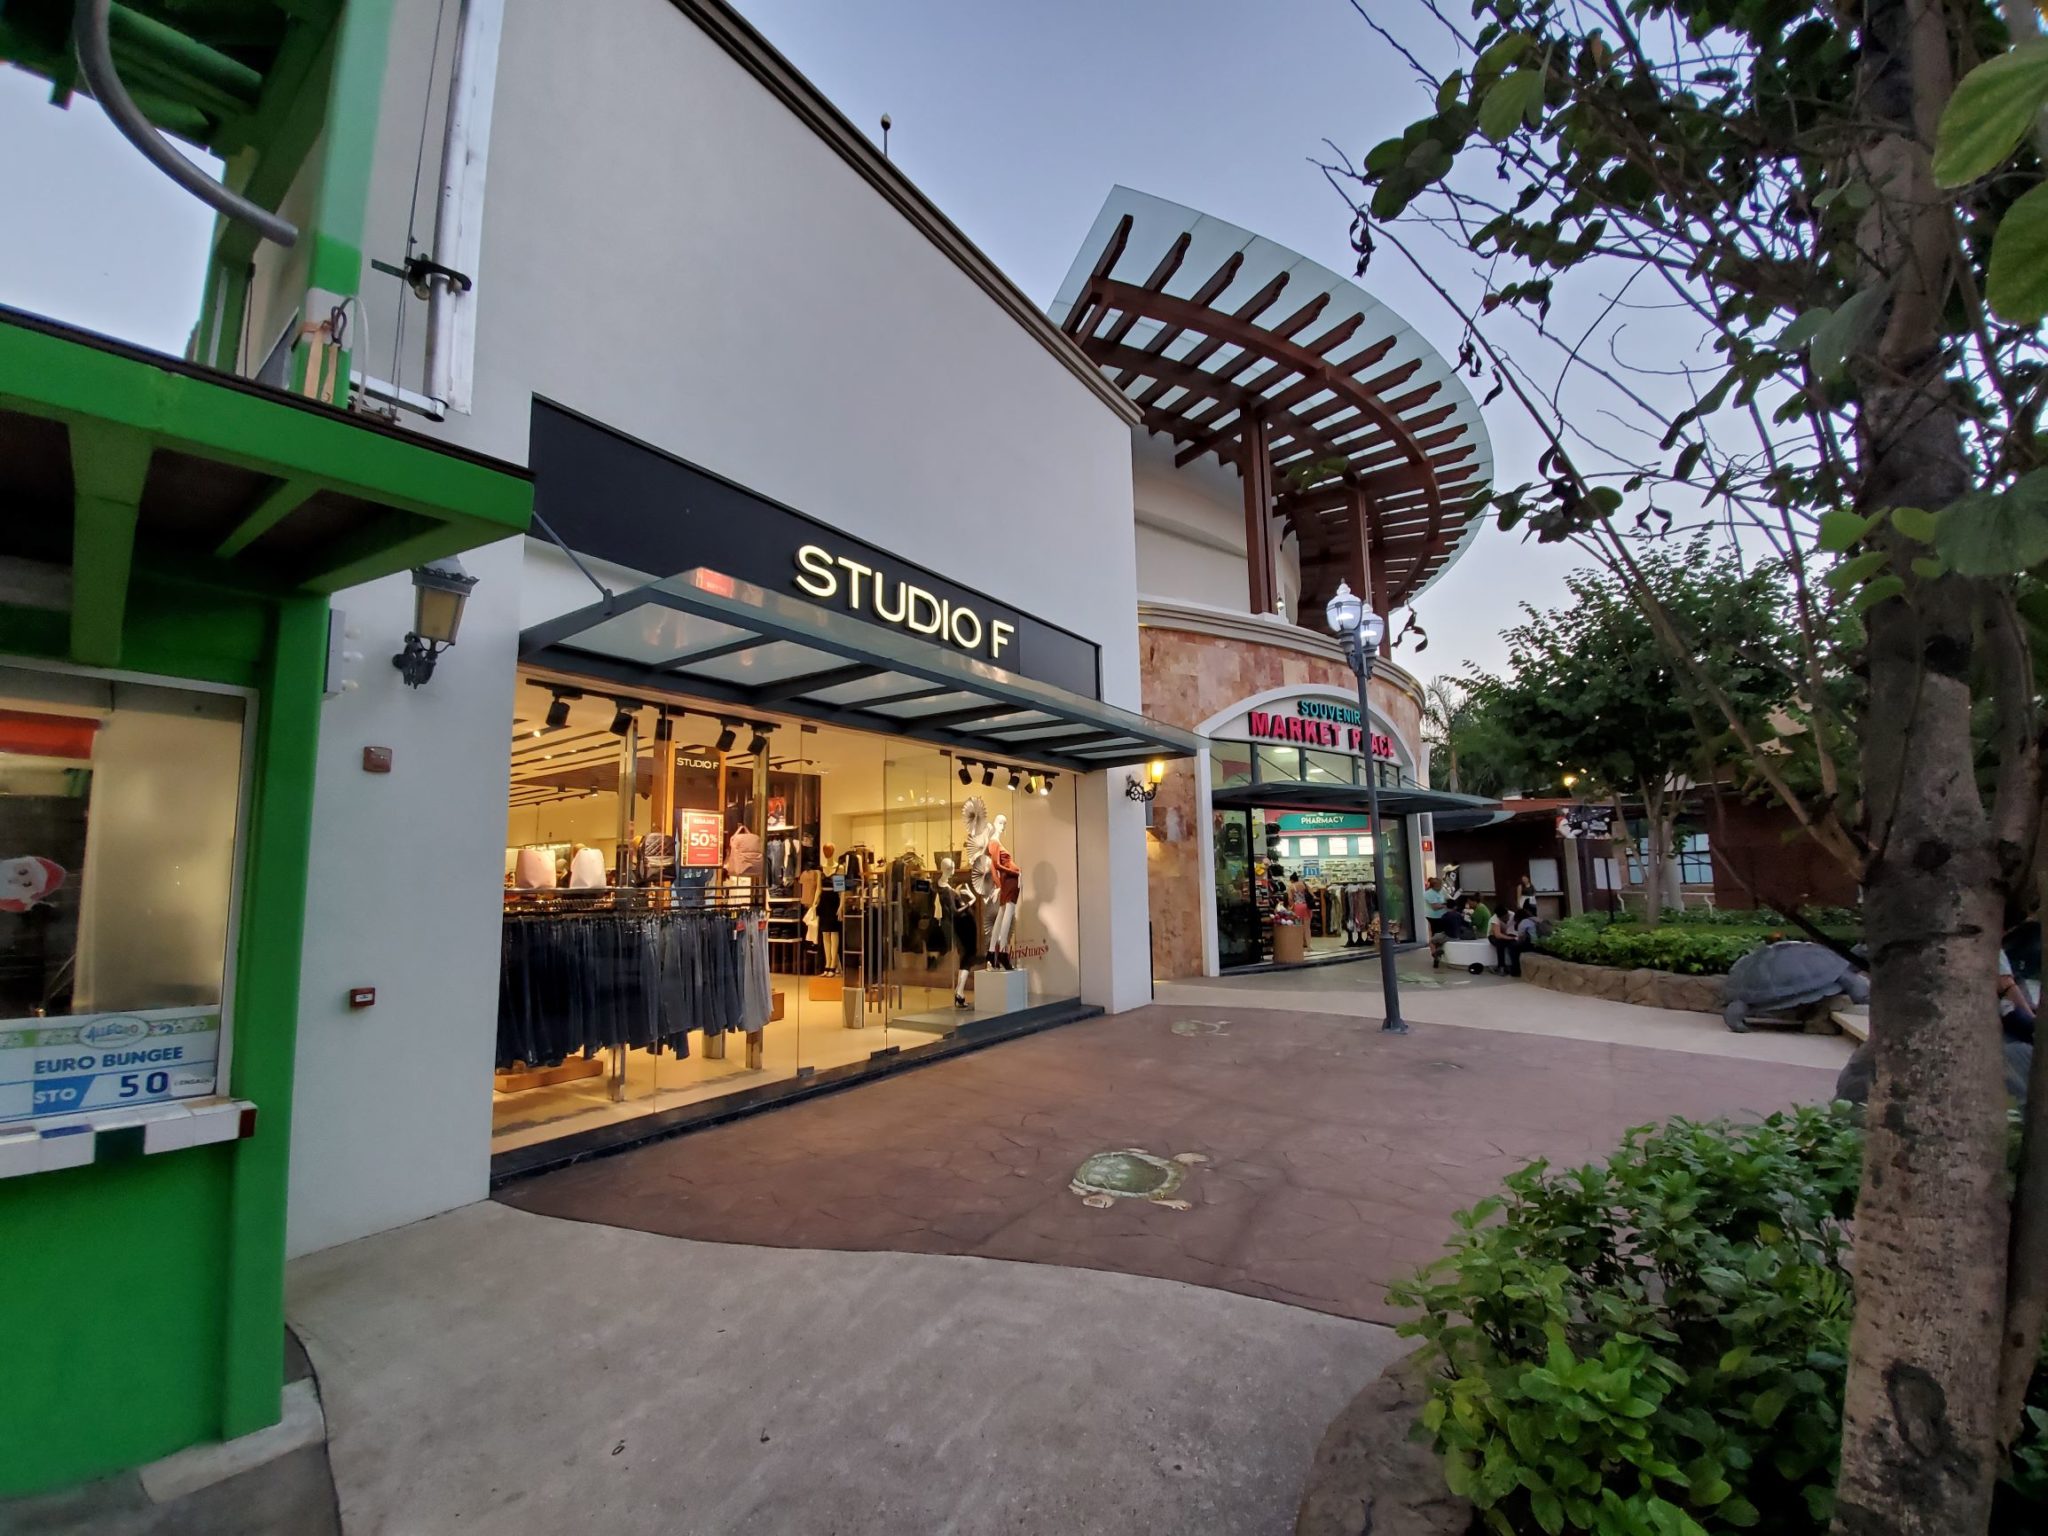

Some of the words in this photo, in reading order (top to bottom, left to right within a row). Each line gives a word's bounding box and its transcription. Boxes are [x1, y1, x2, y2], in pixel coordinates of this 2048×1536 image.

[796, 544, 982, 648] STUDIO
[992, 619, 1015, 659] F
[1248, 711, 1341, 747] MARKET
[1349, 727, 1394, 758] PACE
[676, 757, 712, 769] STUDIO
[713, 762, 720, 770] F
[1301, 816, 1344, 824] PHARMACY
[35, 1055, 96, 1074] EURO
[102, 1046, 183, 1067] BUNGEE
